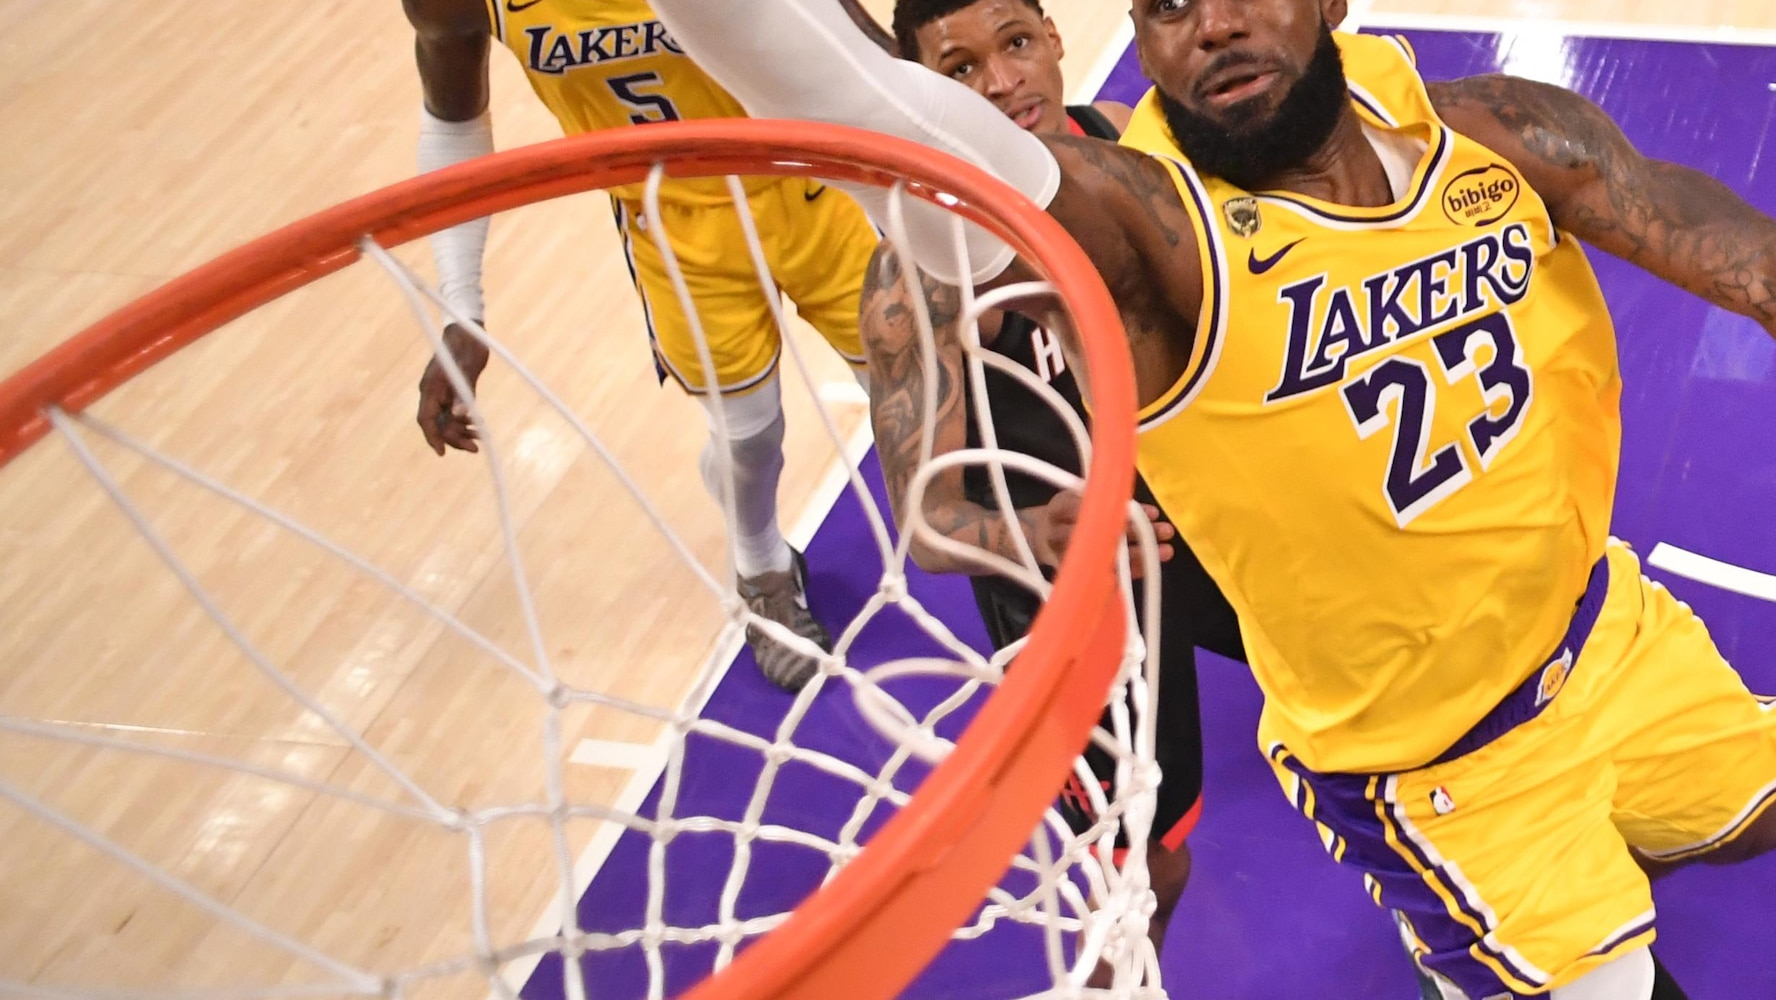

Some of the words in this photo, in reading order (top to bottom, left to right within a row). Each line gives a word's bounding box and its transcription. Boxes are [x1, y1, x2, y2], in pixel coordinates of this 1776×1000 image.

[523, 20, 685, 76] LAKER
[605, 71, 683, 126] 5
[1447, 179, 1514, 213] bibigo
[1262, 223, 1534, 406] LAKERS
[1338, 309, 1534, 529] 23
